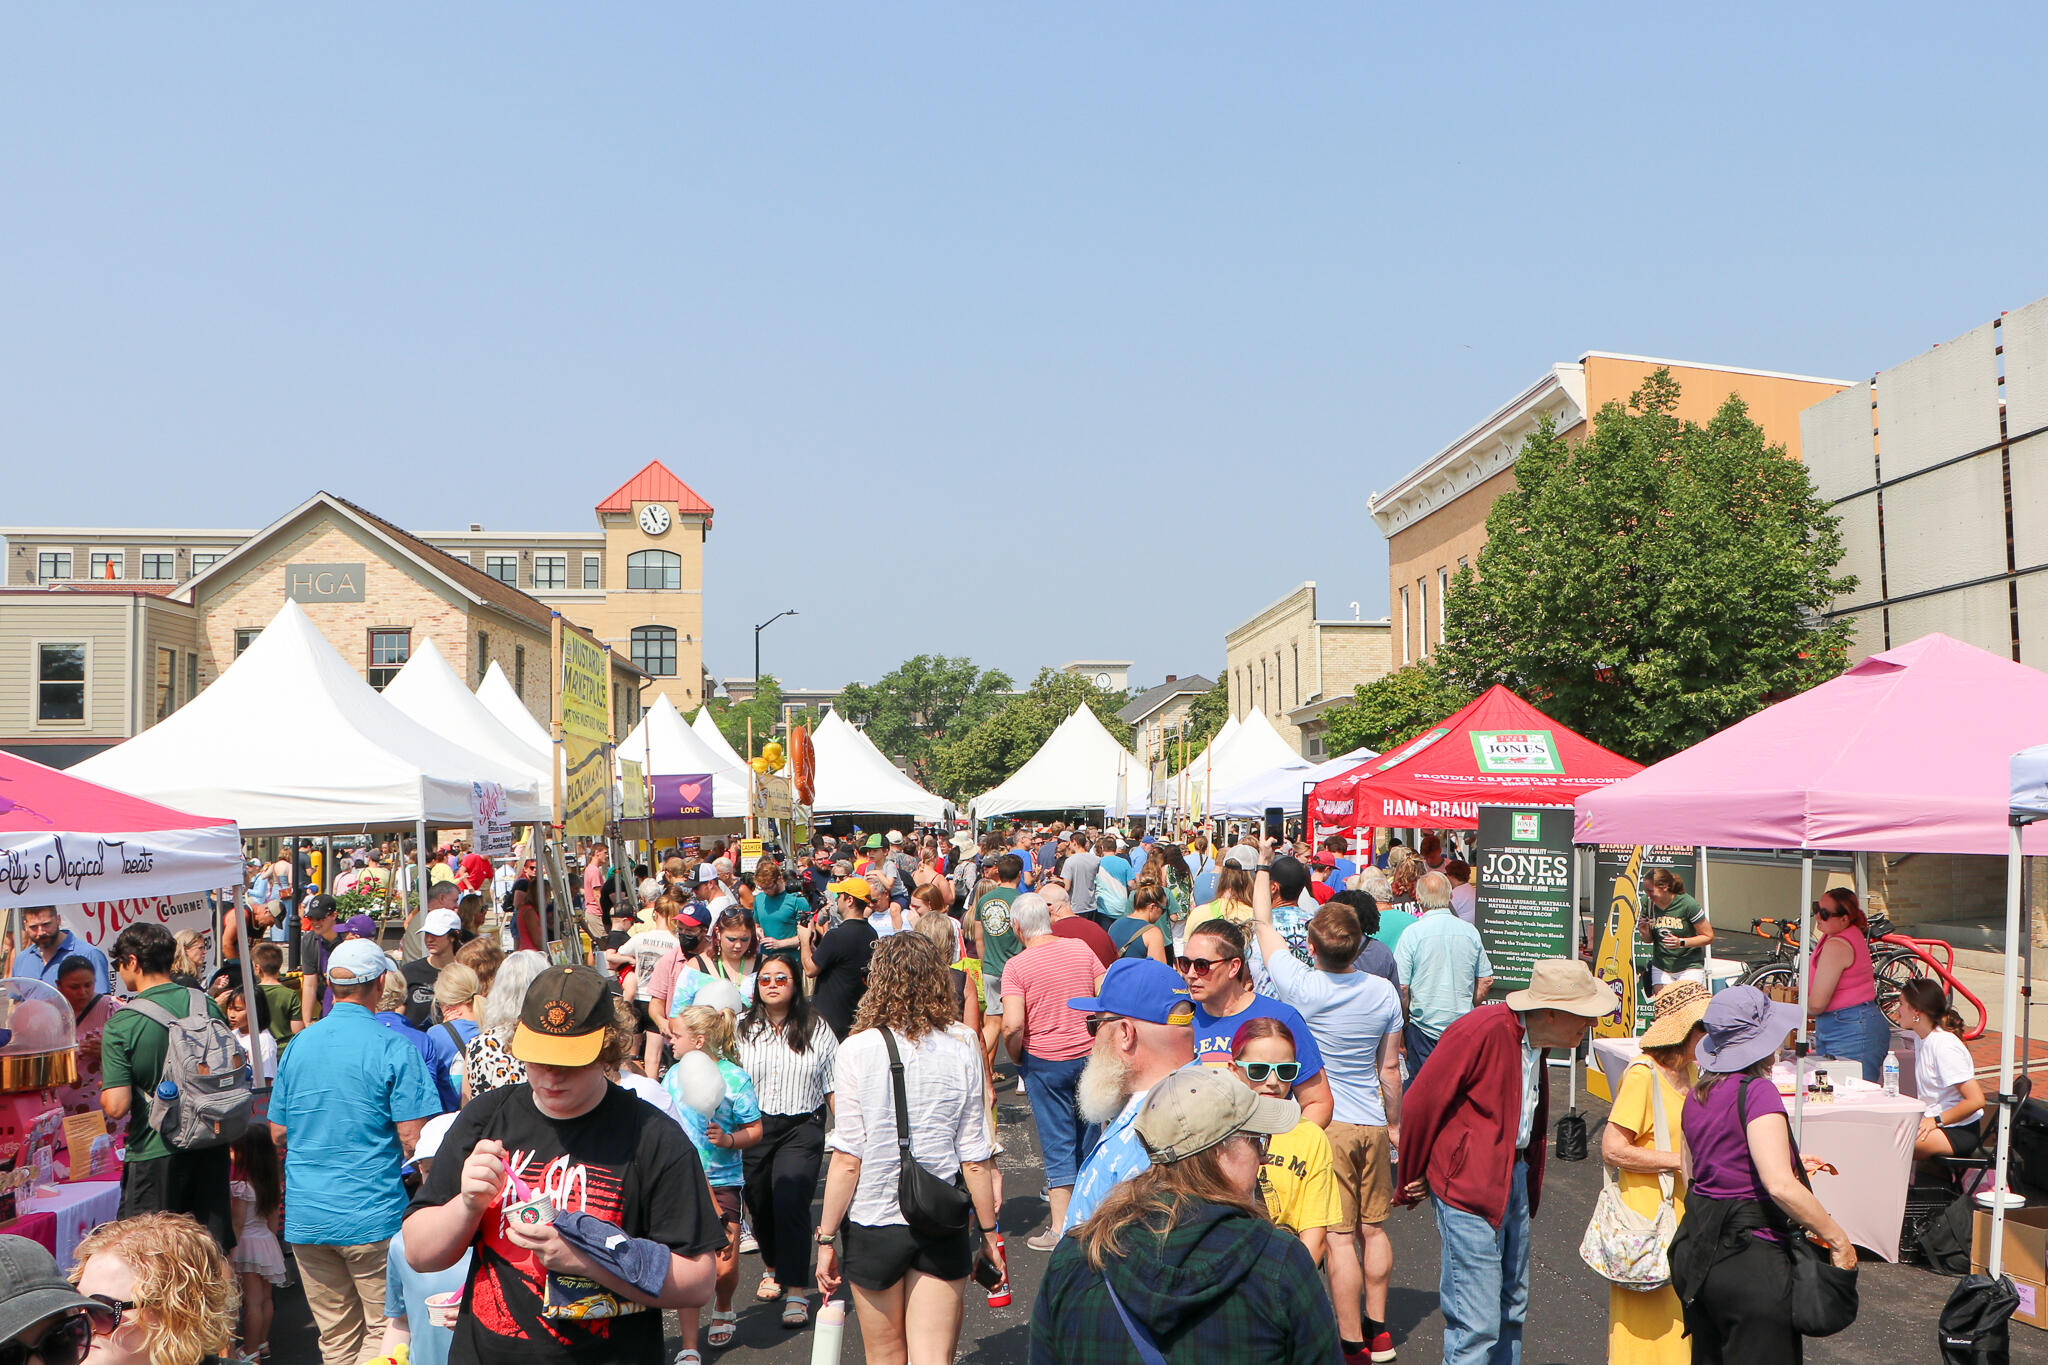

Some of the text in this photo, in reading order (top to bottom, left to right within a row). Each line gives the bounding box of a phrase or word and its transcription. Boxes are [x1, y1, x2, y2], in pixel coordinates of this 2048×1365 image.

[293, 572, 356, 594] HGA
[572, 637, 600, 676] MUSTARD
[1487, 744, 1545, 754] JONES
[1414, 773, 1475, 781] PROUDLY
[1383, 800, 1418, 817] HAM
[45, 834, 105, 890] Magical
[103, 838, 153, 874] Treats
[1482, 853, 1568, 877] JONES
[1482, 874, 1568, 886] DAIRY FARM
[1539, 900, 1571, 908] MEATBALLS,
[643, 938, 673, 949] BUILT FOR
